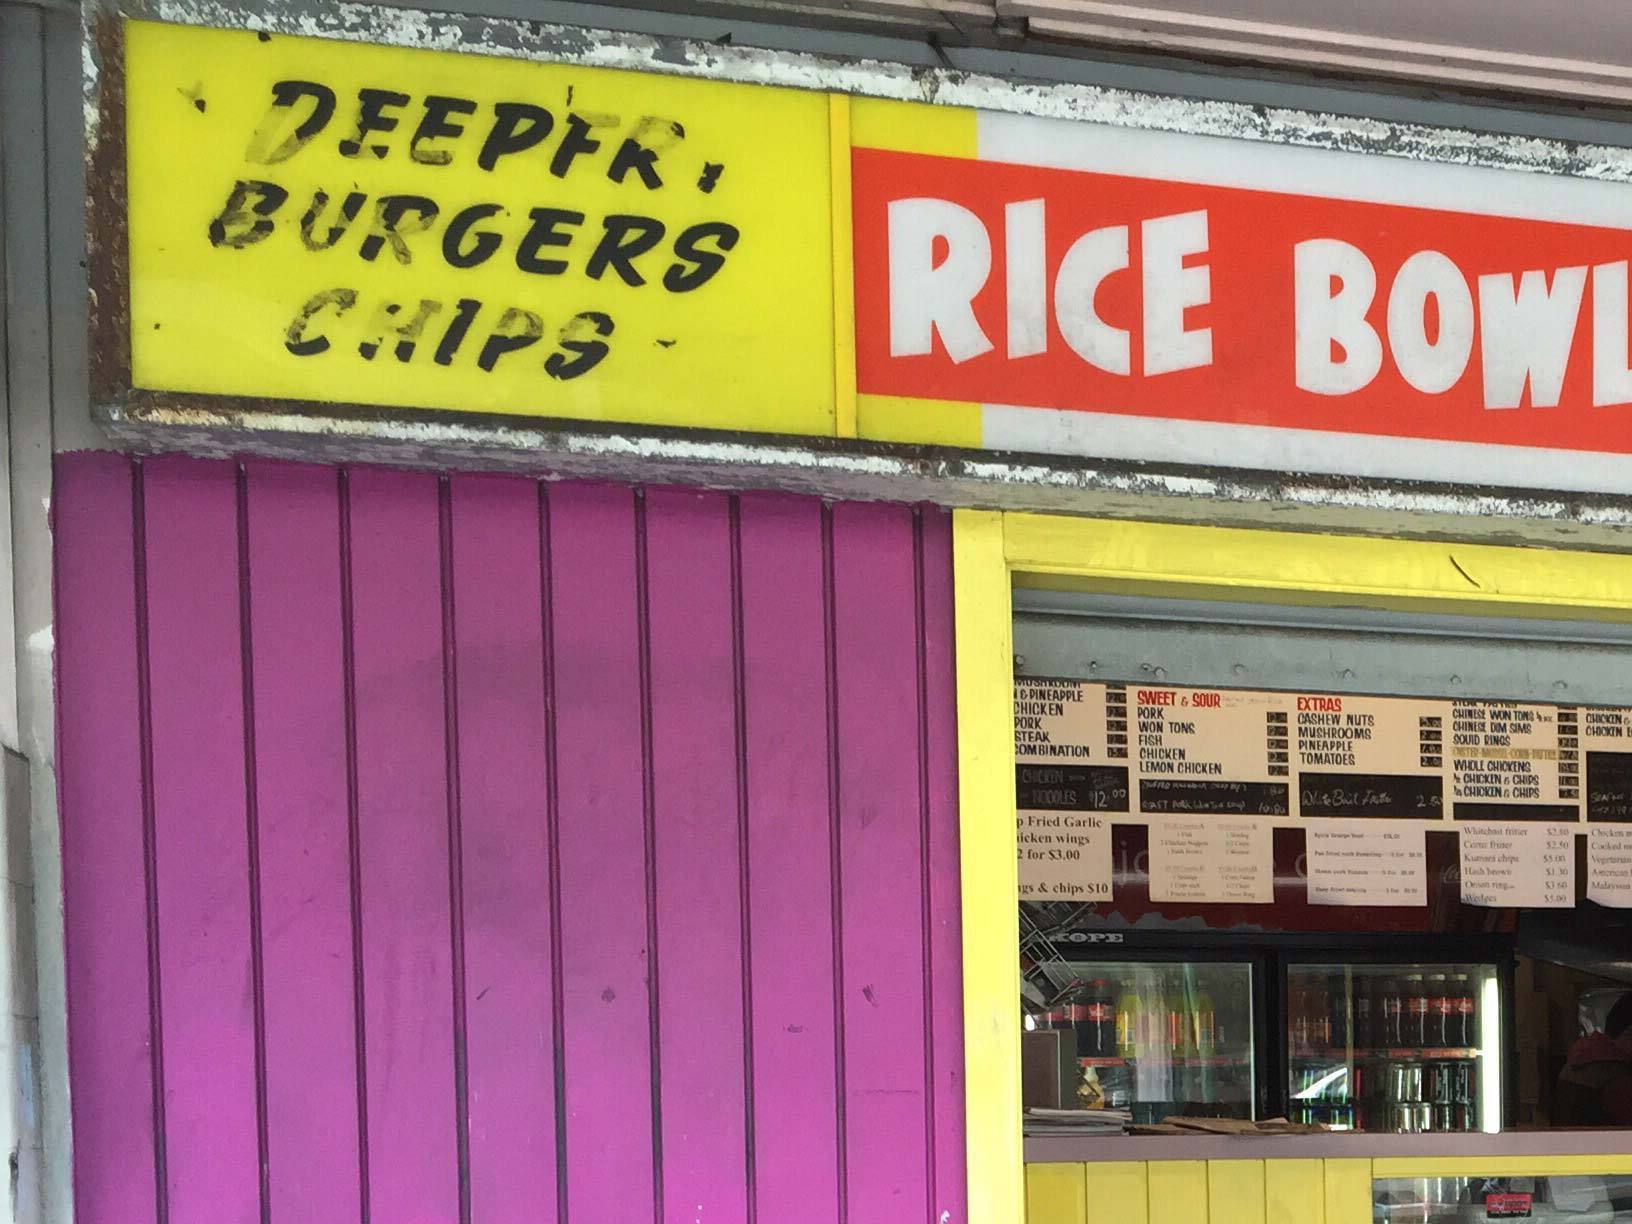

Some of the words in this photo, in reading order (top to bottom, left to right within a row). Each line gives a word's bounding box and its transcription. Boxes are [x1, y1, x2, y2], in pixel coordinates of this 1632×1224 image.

[208, 179, 741, 293] BURGERS
[887, 198, 1213, 377] RICE
[285, 289, 616, 381] CHIPS
[1029, 690, 1083, 702] PINEAPPLE
[1137, 690, 1177, 706] SWEET
[1181, 697, 1188, 706] &
[1192, 692, 1221, 708] SOUR
[1014, 702, 1063, 716] CHICKEN
[1297, 697, 1342, 712] EXTRAS
[1137, 707, 1164, 720] PORK
[1298, 713, 1340, 725] CASHEW
[1347, 714, 1374, 726] NUTS
[1452, 709, 1486, 720] CHINESE
[1585, 713, 1622, 724] CHICKEN
[1014, 717, 1042, 729] PORK
[1138, 721, 1163, 733] WON
[1168, 722, 1195, 734] TONS
[1453, 721, 1486, 733] CHINESE
[1015, 731, 1050, 743] STEAK
[1298, 727, 1372, 740] MUSHROOMS
[1585, 726, 1622, 737] CHICKEN
[1138, 734, 1163, 746] FISH
[1298, 740, 1353, 751] PINEAPPLE
[1139, 748, 1185, 760] CHICKEN
[1300, 753, 1355, 765] TOMATOES
[1139, 761, 1174, 773] LEMON
[1177, 763, 1222, 775] CHICKEN
[1487, 761, 1531, 772] CHICKENS
[1463, 773, 1501, 785] CHICKEN
[1513, 775, 1539, 785] CHIPS
[1464, 786, 1501, 797] CHICKEN
[1513, 787, 1540, 798] CHIPS
[1028, 816, 1060, 828] Fried
[1064, 816, 1102, 829] Garlic
[1592, 829, 1624, 837] Chicken
[1056, 833, 1090, 846] wings
[1027, 849, 1046, 860] for
[1049, 849, 1080, 861] $3.00
[1498, 854, 1519, 864] chips
[1037, 883, 1048, 893] &
[1052, 882, 1084, 896] chips
[1087, 883, 1108, 894] $10
